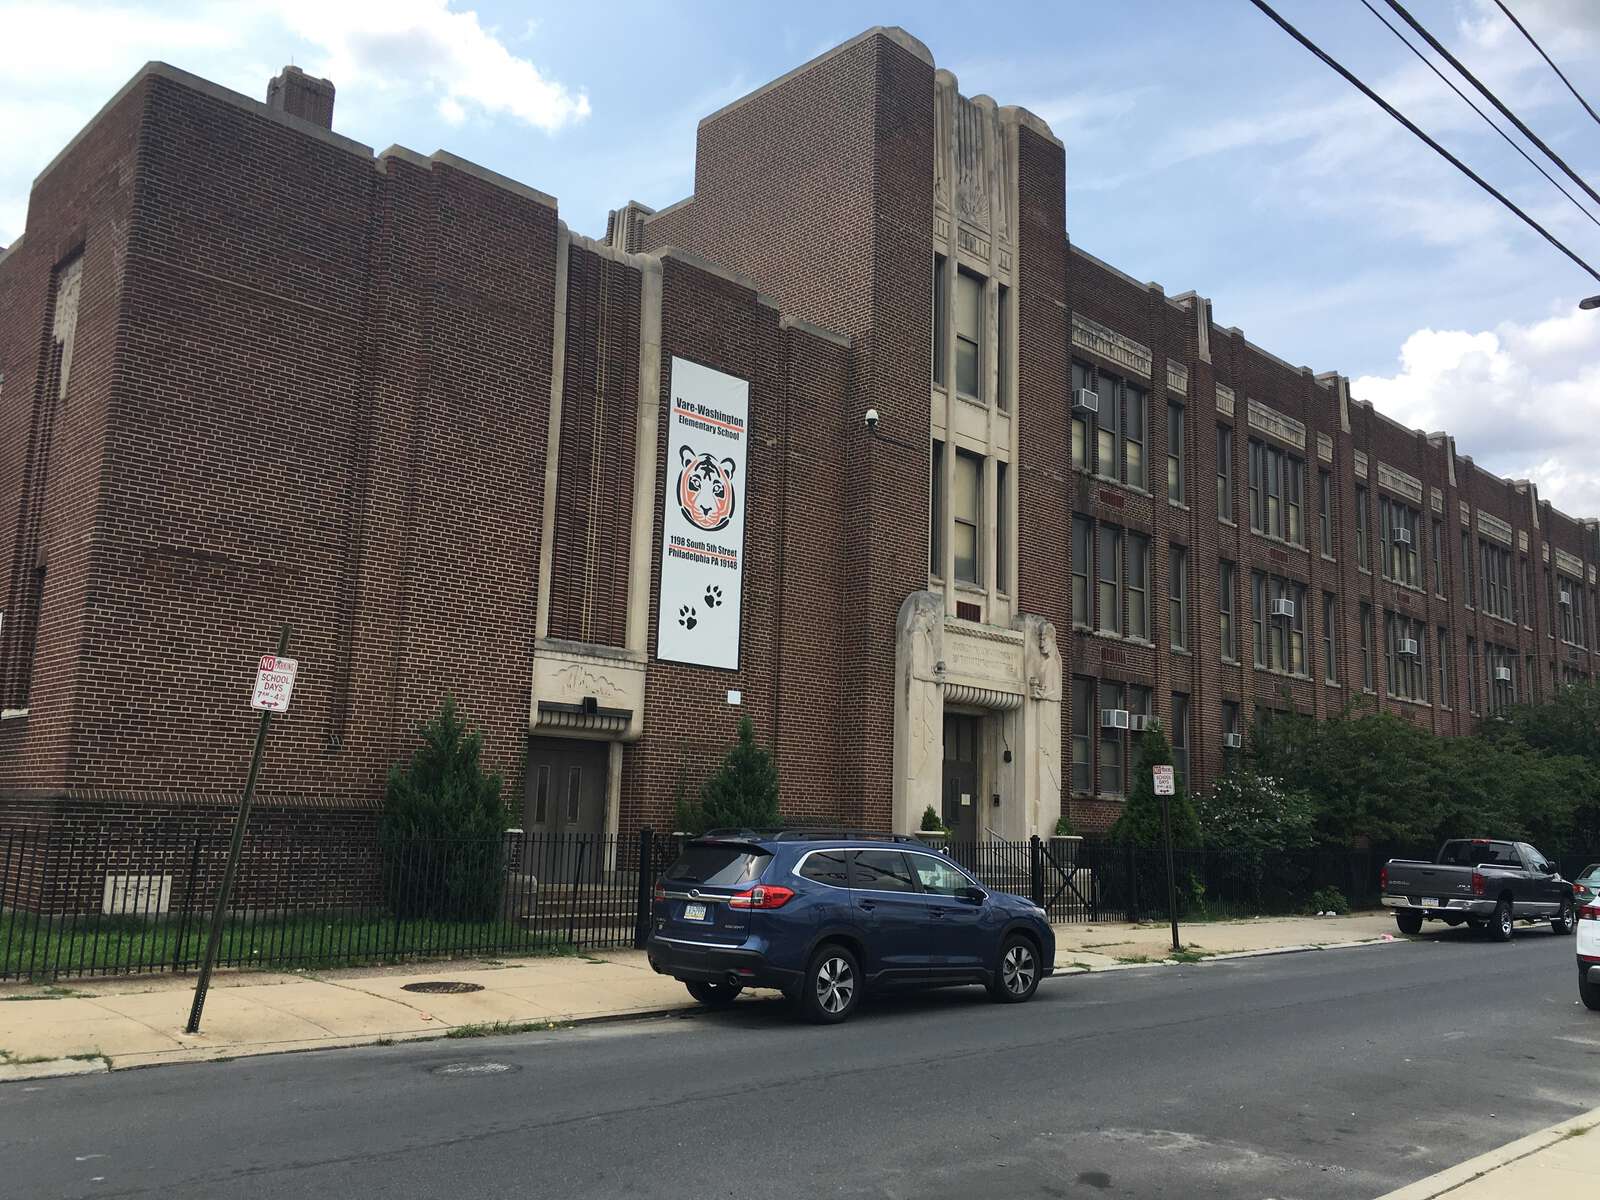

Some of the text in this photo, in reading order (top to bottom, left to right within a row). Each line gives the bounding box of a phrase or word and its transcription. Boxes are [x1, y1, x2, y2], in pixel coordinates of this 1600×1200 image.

[676, 396, 744, 427] Vare-Washington
[678, 414, 740, 441] Elementary School
[670, 535, 737, 558] 1198 South 5th Street
[668, 547, 738, 570] Philadelphia PA 19148
[261, 657, 275, 671] NO
[261, 673, 290, 685] SCHOOL
[264, 682, 284, 692] DAYS
